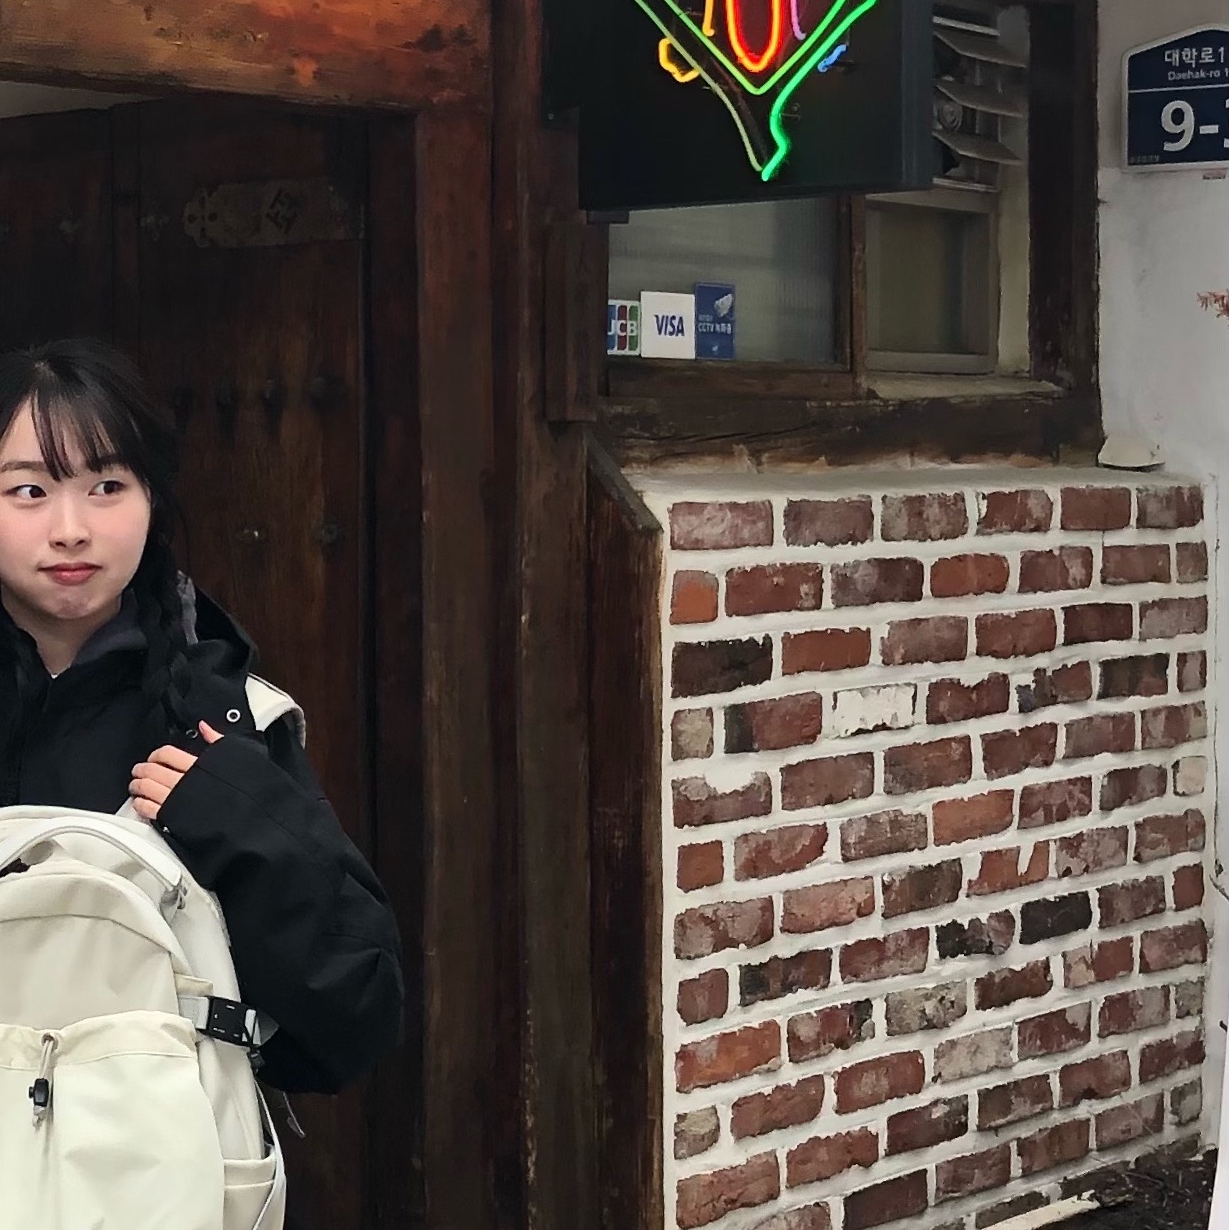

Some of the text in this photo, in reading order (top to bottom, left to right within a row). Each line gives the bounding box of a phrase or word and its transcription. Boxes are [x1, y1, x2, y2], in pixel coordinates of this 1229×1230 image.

[1161, 98, 1229, 152] 9-
[607, 319, 638, 336] JCB
[655, 314, 685, 337] VISA
